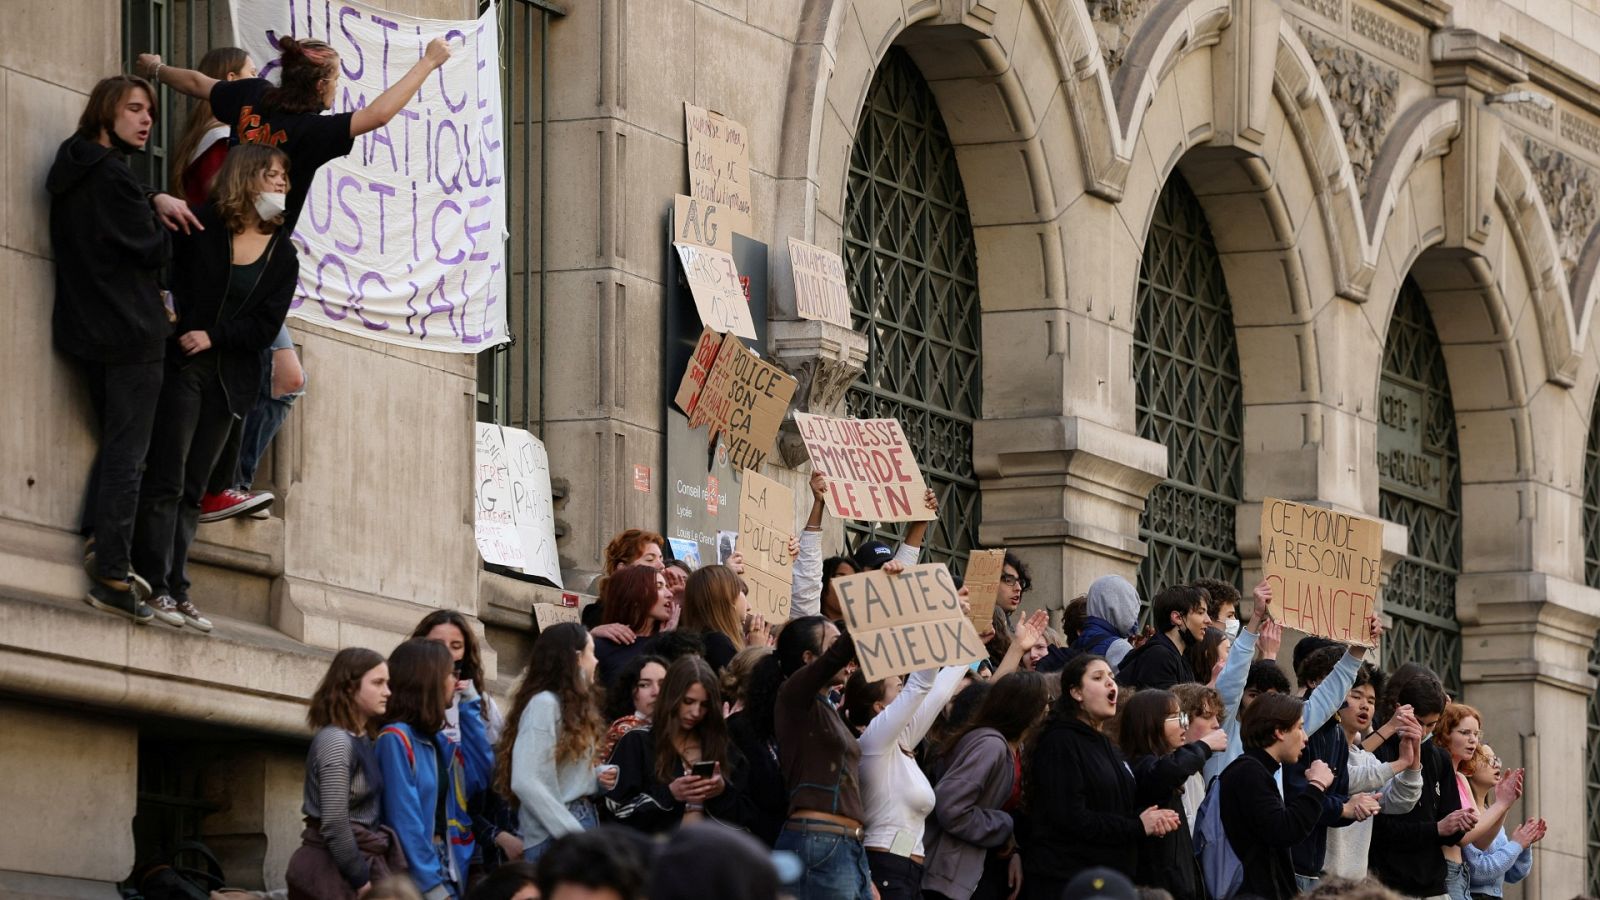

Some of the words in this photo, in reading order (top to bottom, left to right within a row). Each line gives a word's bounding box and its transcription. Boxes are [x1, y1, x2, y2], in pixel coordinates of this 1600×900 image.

[307, 167, 492, 266] USTICE
[682, 199, 718, 247] AG
[682, 245, 721, 284] PARIS
[720, 257, 736, 288] 7
[730, 348, 782, 398] POLICE
[728, 380, 758, 411] SON
[729, 408, 752, 435] ÇA
[799, 419, 817, 440] LA
[812, 416, 903, 447] JEUNESSE
[727, 433, 767, 474] YEUX
[808, 443, 913, 484] EMMERDE
[676, 479, 701, 499] Conseil
[701, 487, 727, 507] rénal
[676, 503, 693, 519] Lycée
[748, 474, 767, 510] LA
[829, 482, 862, 518] LE
[868, 485, 913, 518] FN
[676, 525, 691, 540] Louis
[691, 530, 698, 542] Le
[699, 531, 715, 547] Grand
[743, 513, 787, 567] POLICE
[1271, 501, 1297, 537] CE
[1301, 507, 1360, 552] MONDE
[1266, 536, 1278, 565] A
[1285, 539, 1352, 581] BESOIN
[1360, 556, 1379, 588] DE
[839, 568, 957, 629] FAITES
